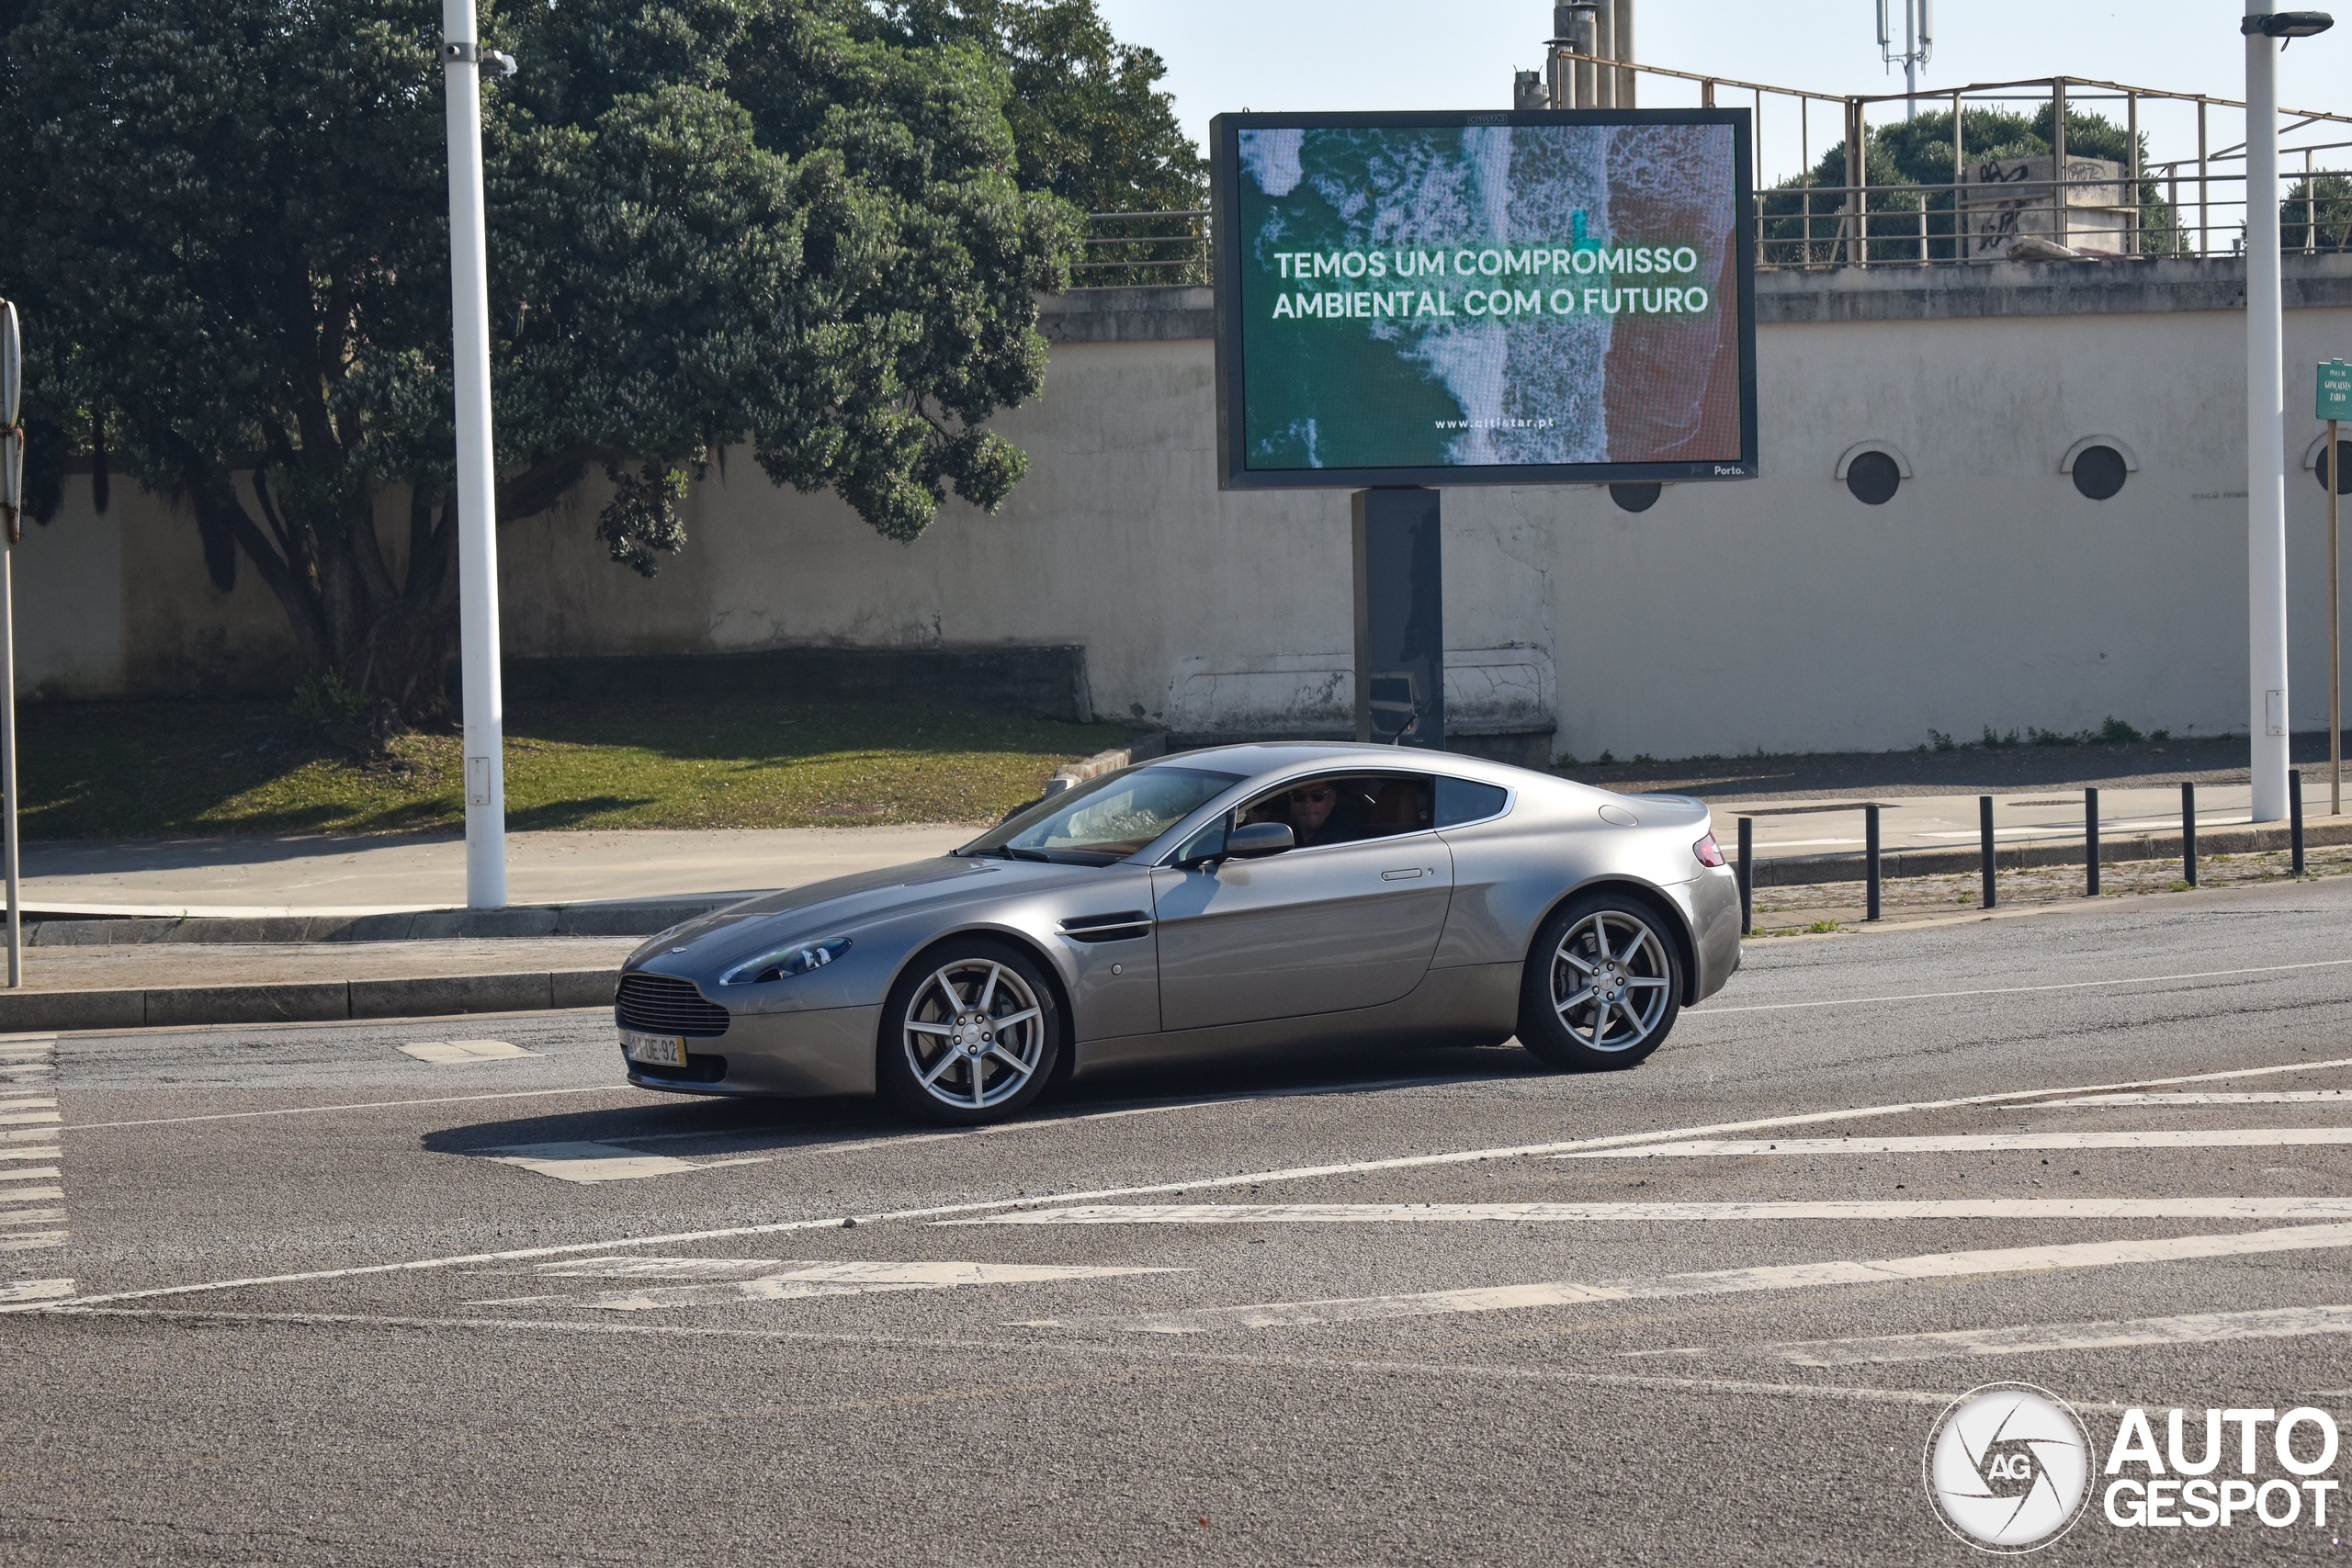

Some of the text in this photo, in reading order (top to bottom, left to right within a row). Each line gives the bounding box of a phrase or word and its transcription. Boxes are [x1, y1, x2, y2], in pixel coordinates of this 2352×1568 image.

[1470, 116, 1505, 124] CITISTAR
[1273, 247, 1698, 278] TEMOS UM COMPROMISSO
[1272, 287, 1709, 319] AMBIENTAL COM O FUTURO
[2329, 392, 2346, 402] ZARCO
[1435, 417, 1555, 430] www.citistar.pt
[1714, 465, 1745, 476] Porto.
